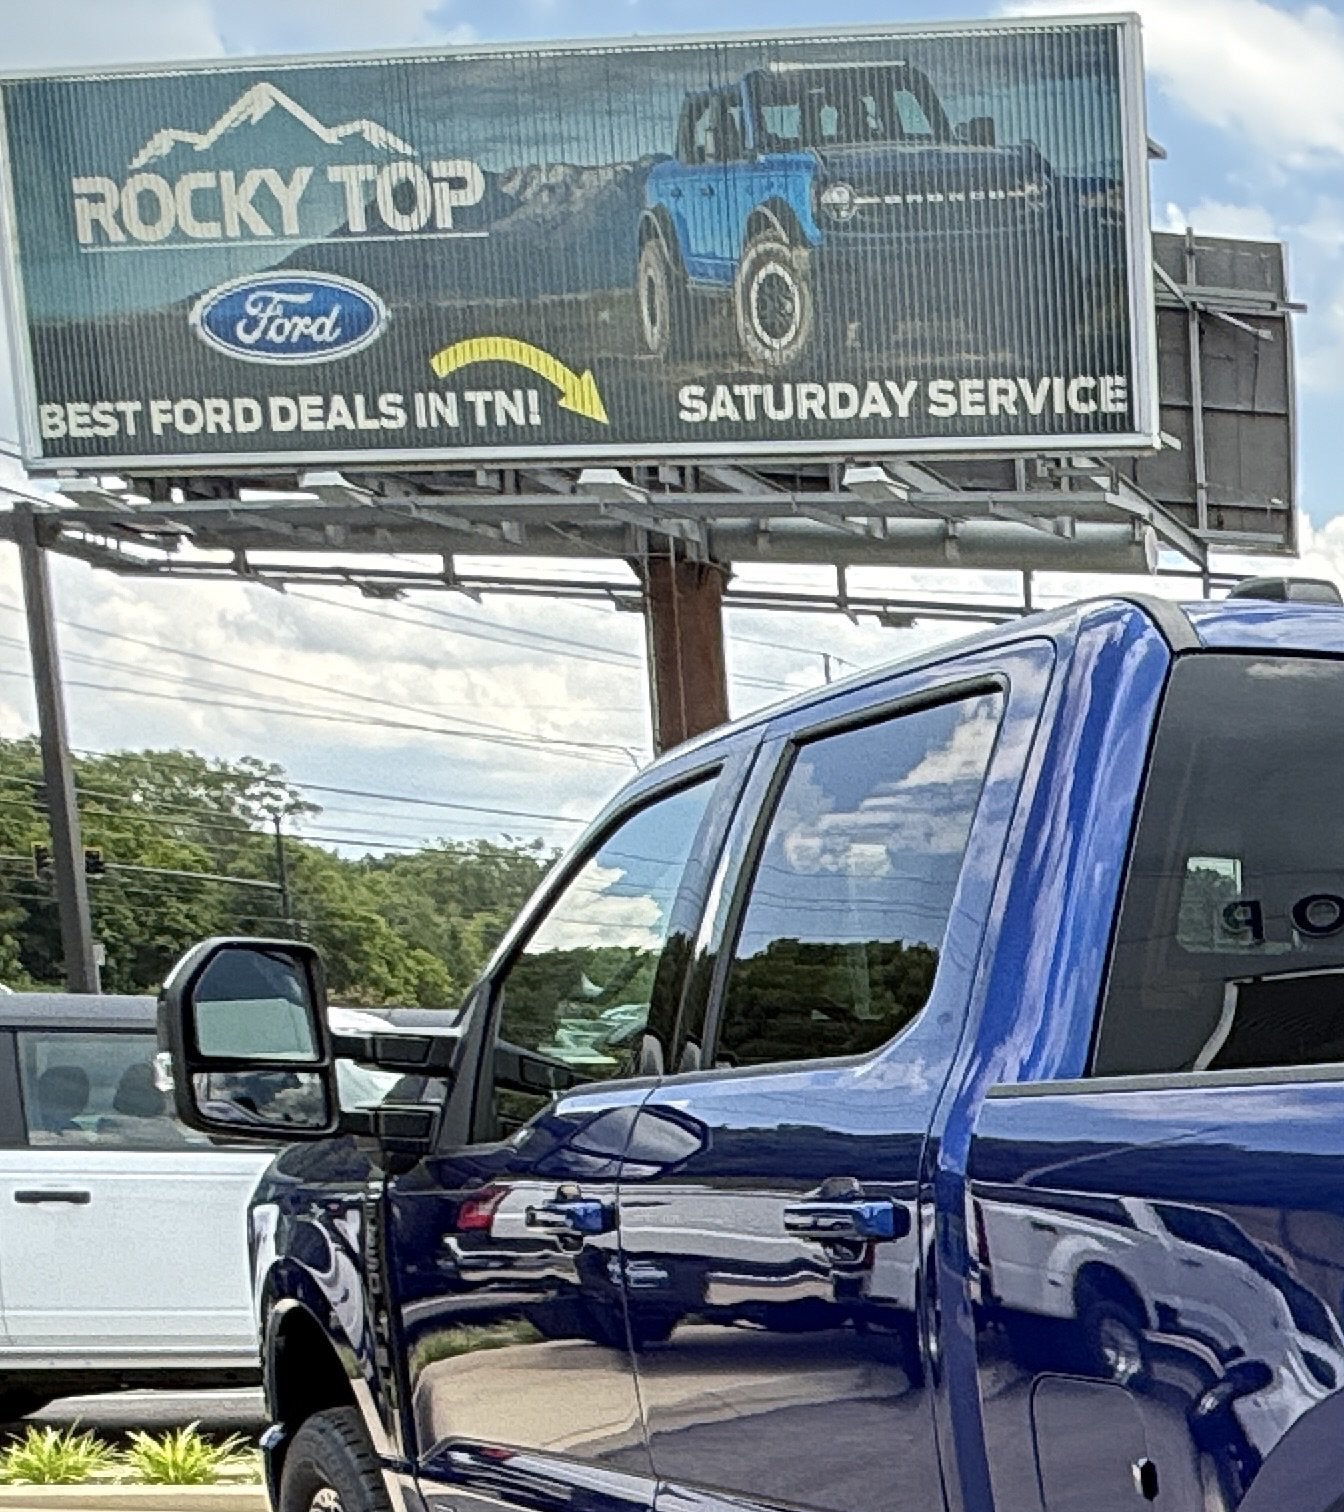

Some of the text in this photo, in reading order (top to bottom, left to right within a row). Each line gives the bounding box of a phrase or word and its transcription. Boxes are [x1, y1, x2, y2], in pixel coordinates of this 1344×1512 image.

[72, 157, 486, 245] ROCKY TOP
[235, 288, 343, 346] Ford
[40, 387, 542, 440] BEST FORD DEALS IN TN!
[677, 374, 1129, 423] SATURDAY SERVICE
